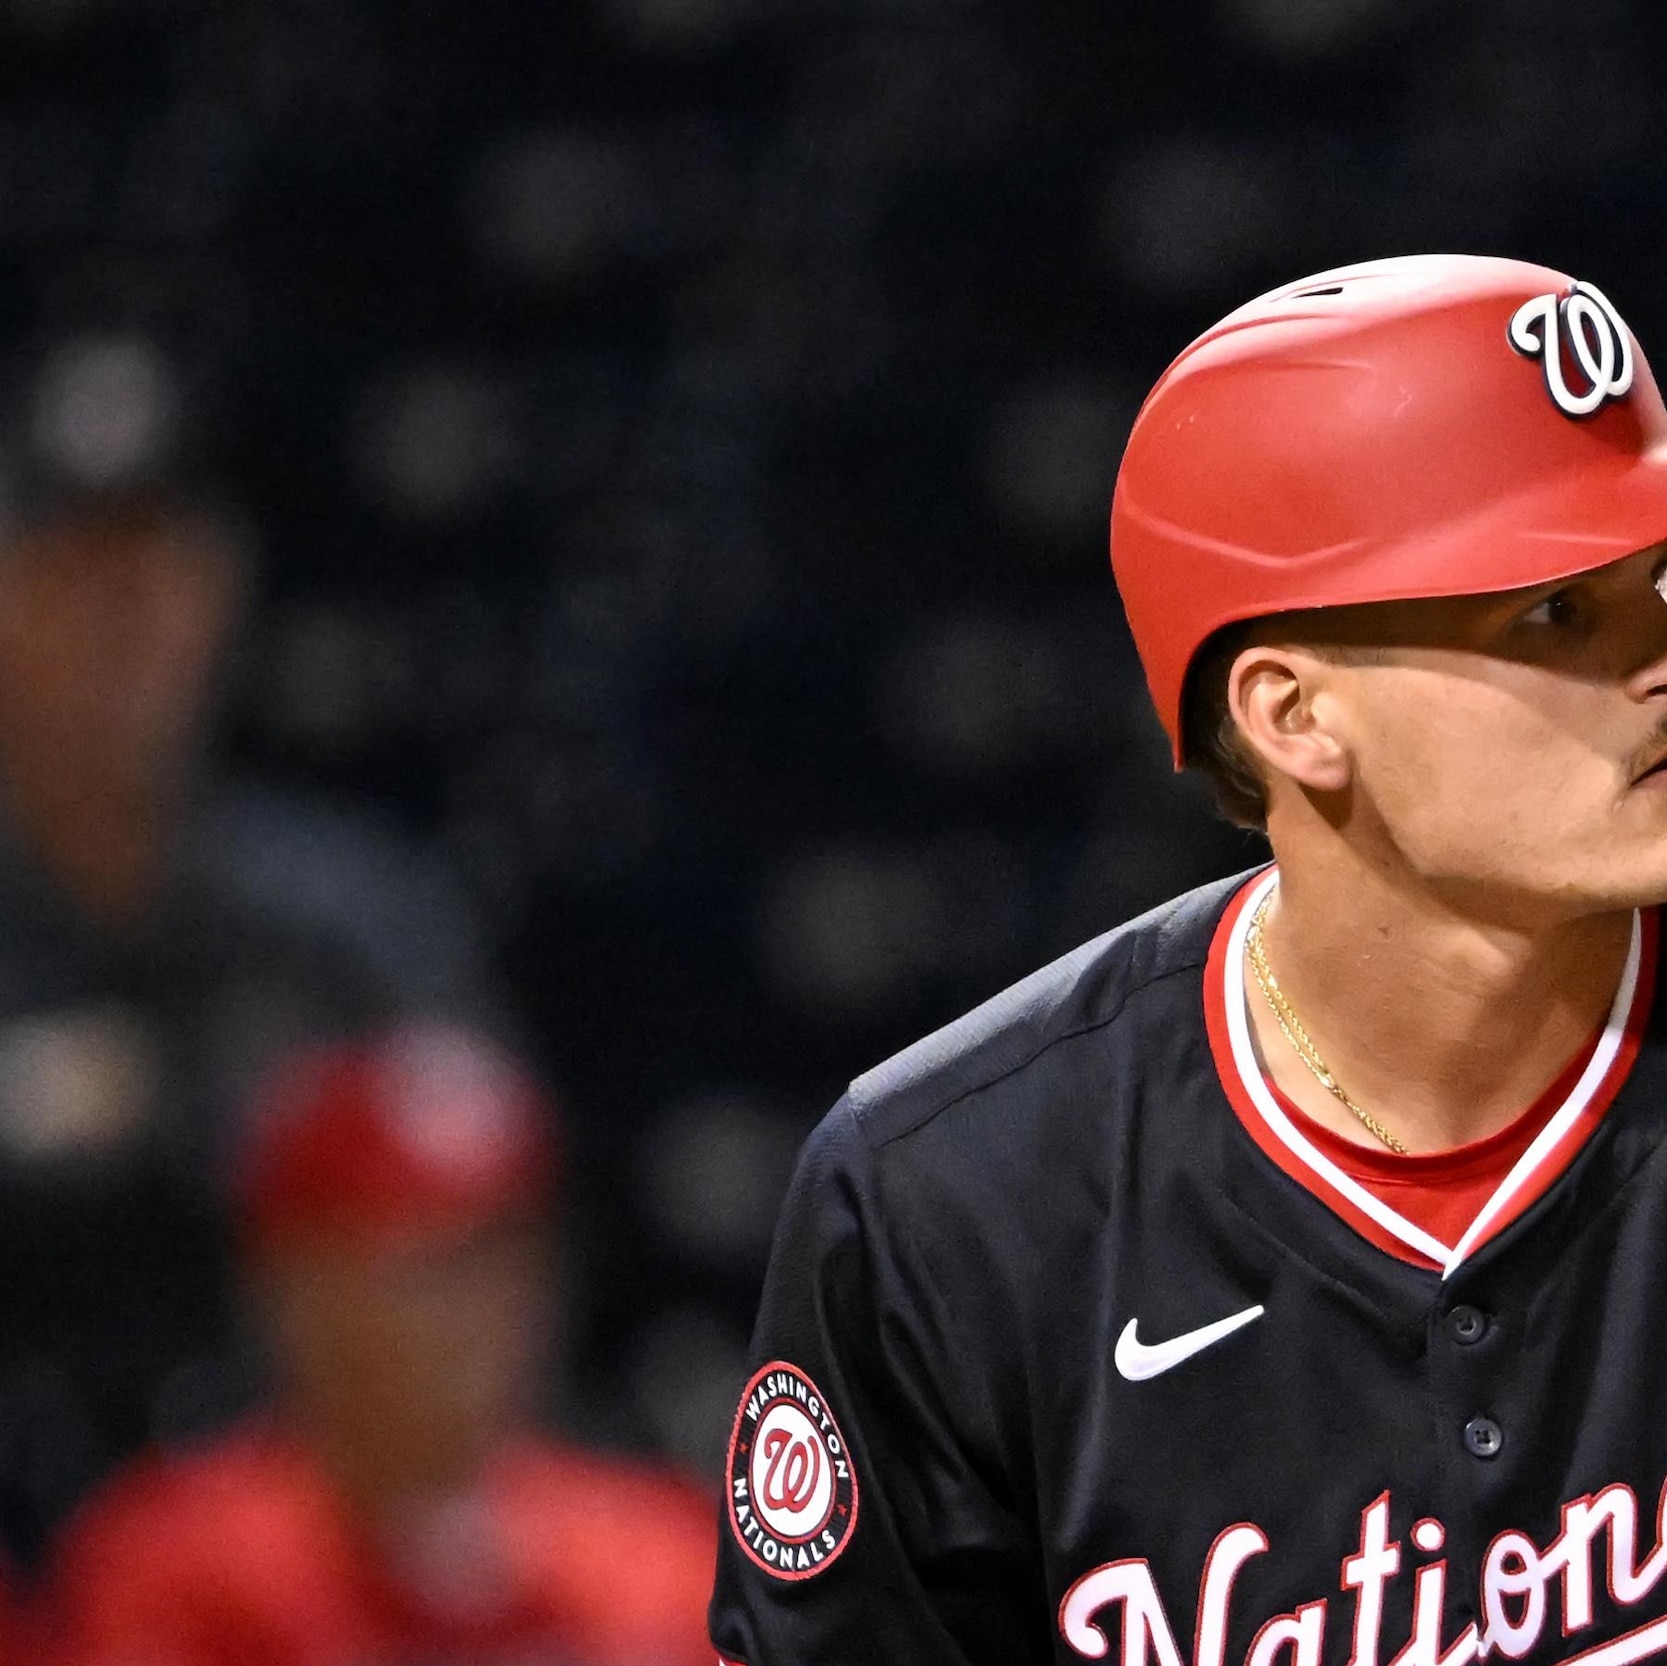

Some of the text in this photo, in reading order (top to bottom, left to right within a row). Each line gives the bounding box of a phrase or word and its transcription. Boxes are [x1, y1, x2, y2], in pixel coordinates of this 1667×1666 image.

[1507, 280, 1634, 419] W
[745, 1373, 849, 1479] WASHINGTON
[763, 1428, 821, 1513] W
[734, 1478, 836, 1570] NATIONALS
